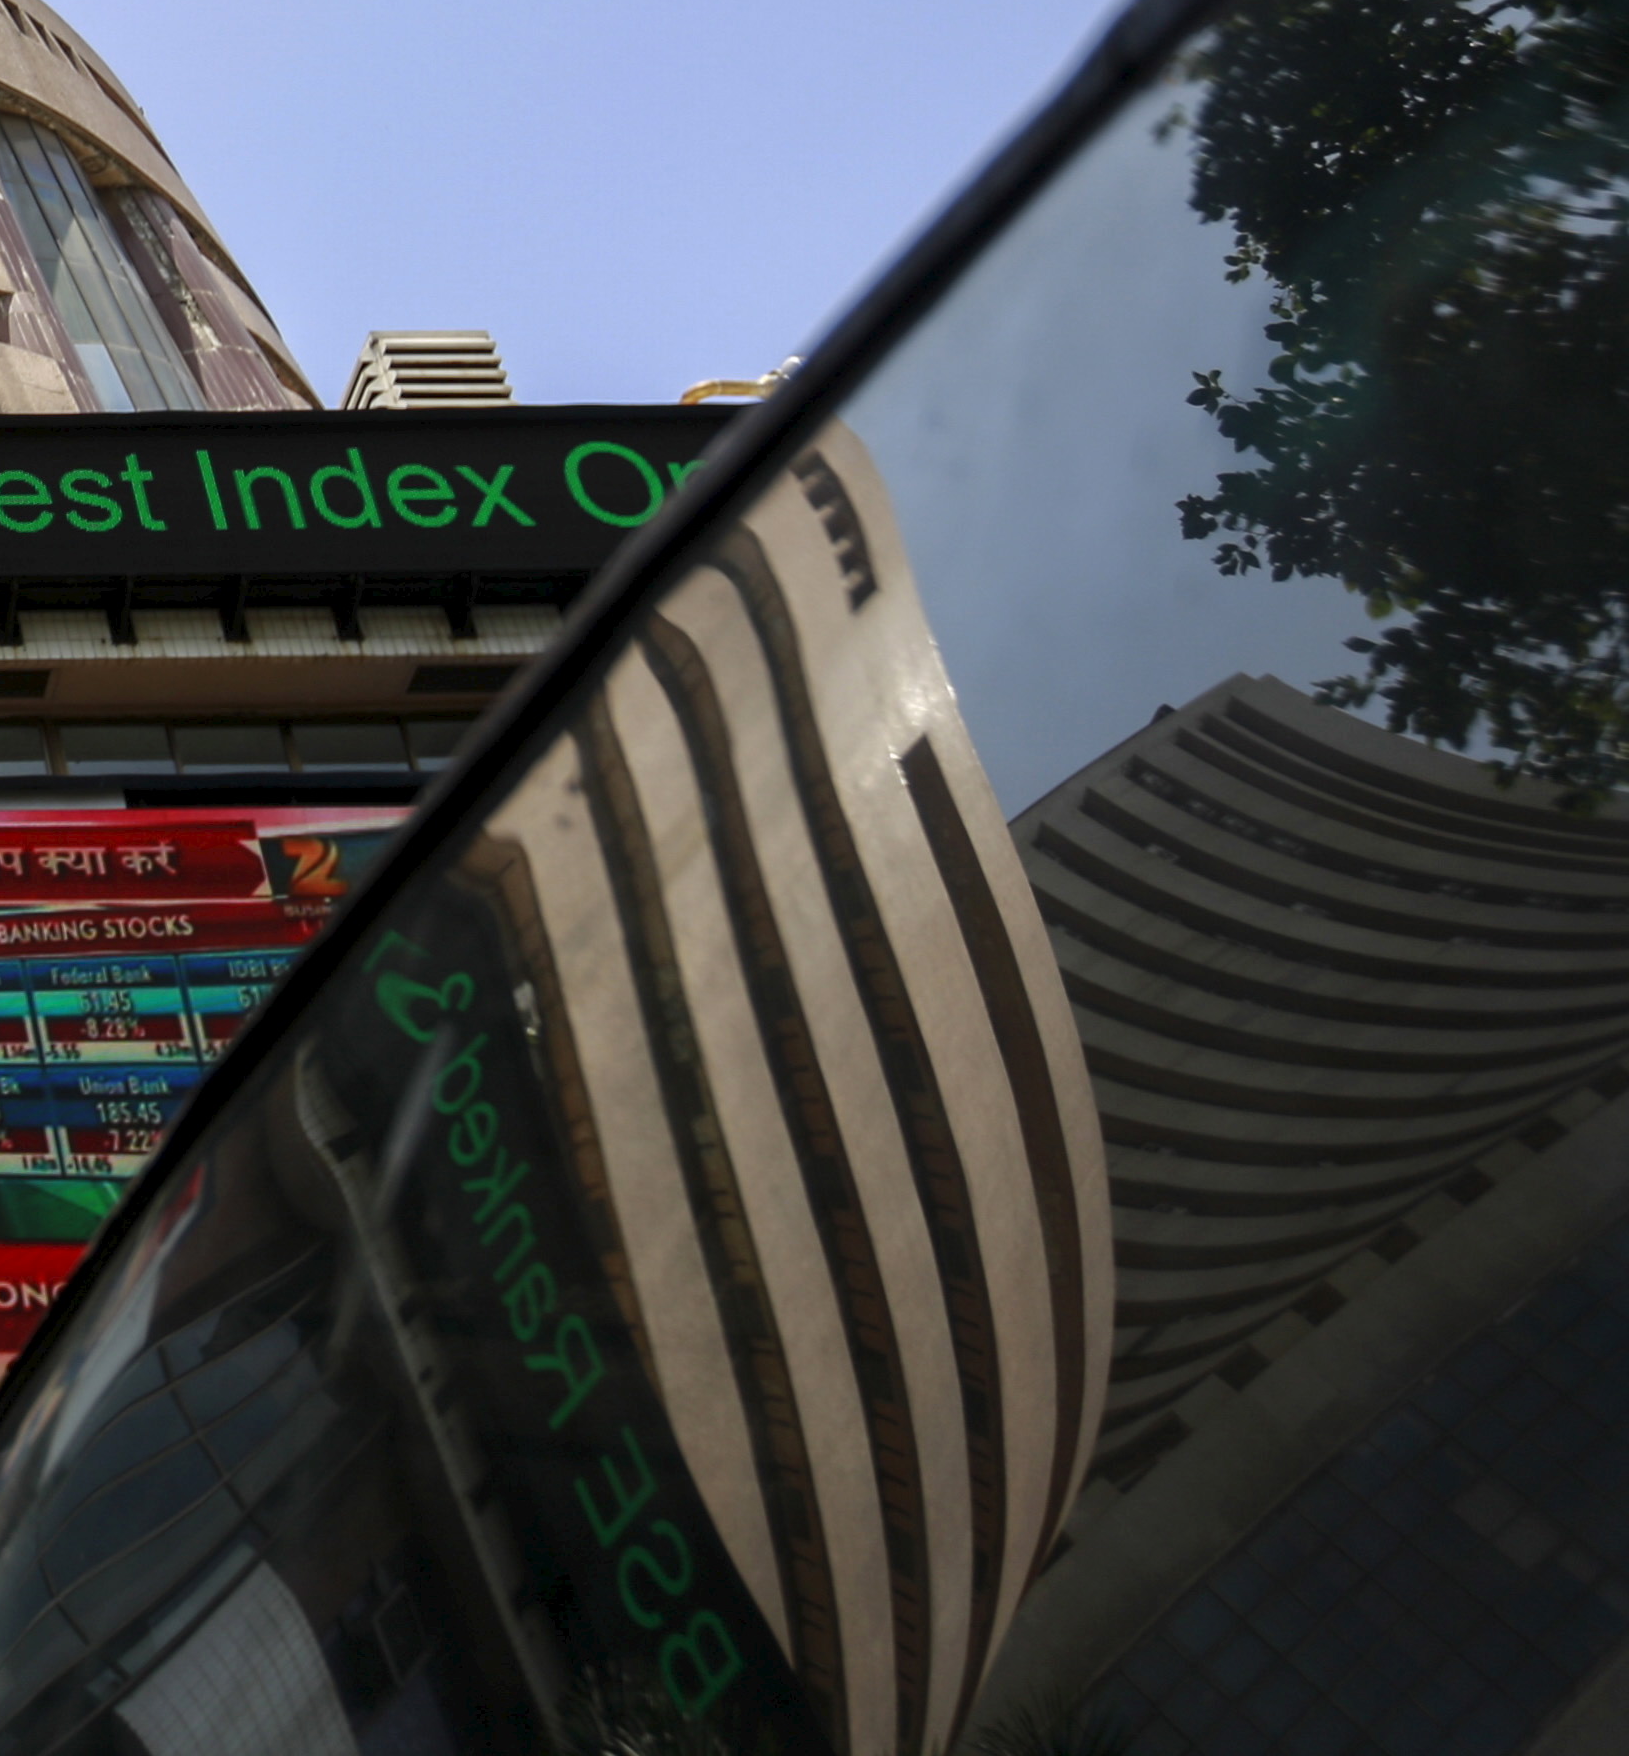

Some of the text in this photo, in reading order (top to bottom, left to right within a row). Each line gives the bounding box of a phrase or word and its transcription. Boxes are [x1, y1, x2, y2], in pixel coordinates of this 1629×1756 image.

[196, 448, 536, 531] Index
[34, 845, 108, 877] क्या
[123, 839, 177, 875] करें
[105, 914, 194, 939] STOCKS
[50, 966, 108, 985] Federal
[78, 1076, 125, 1095] Union
[95, 1101, 163, 1124] 185.45
